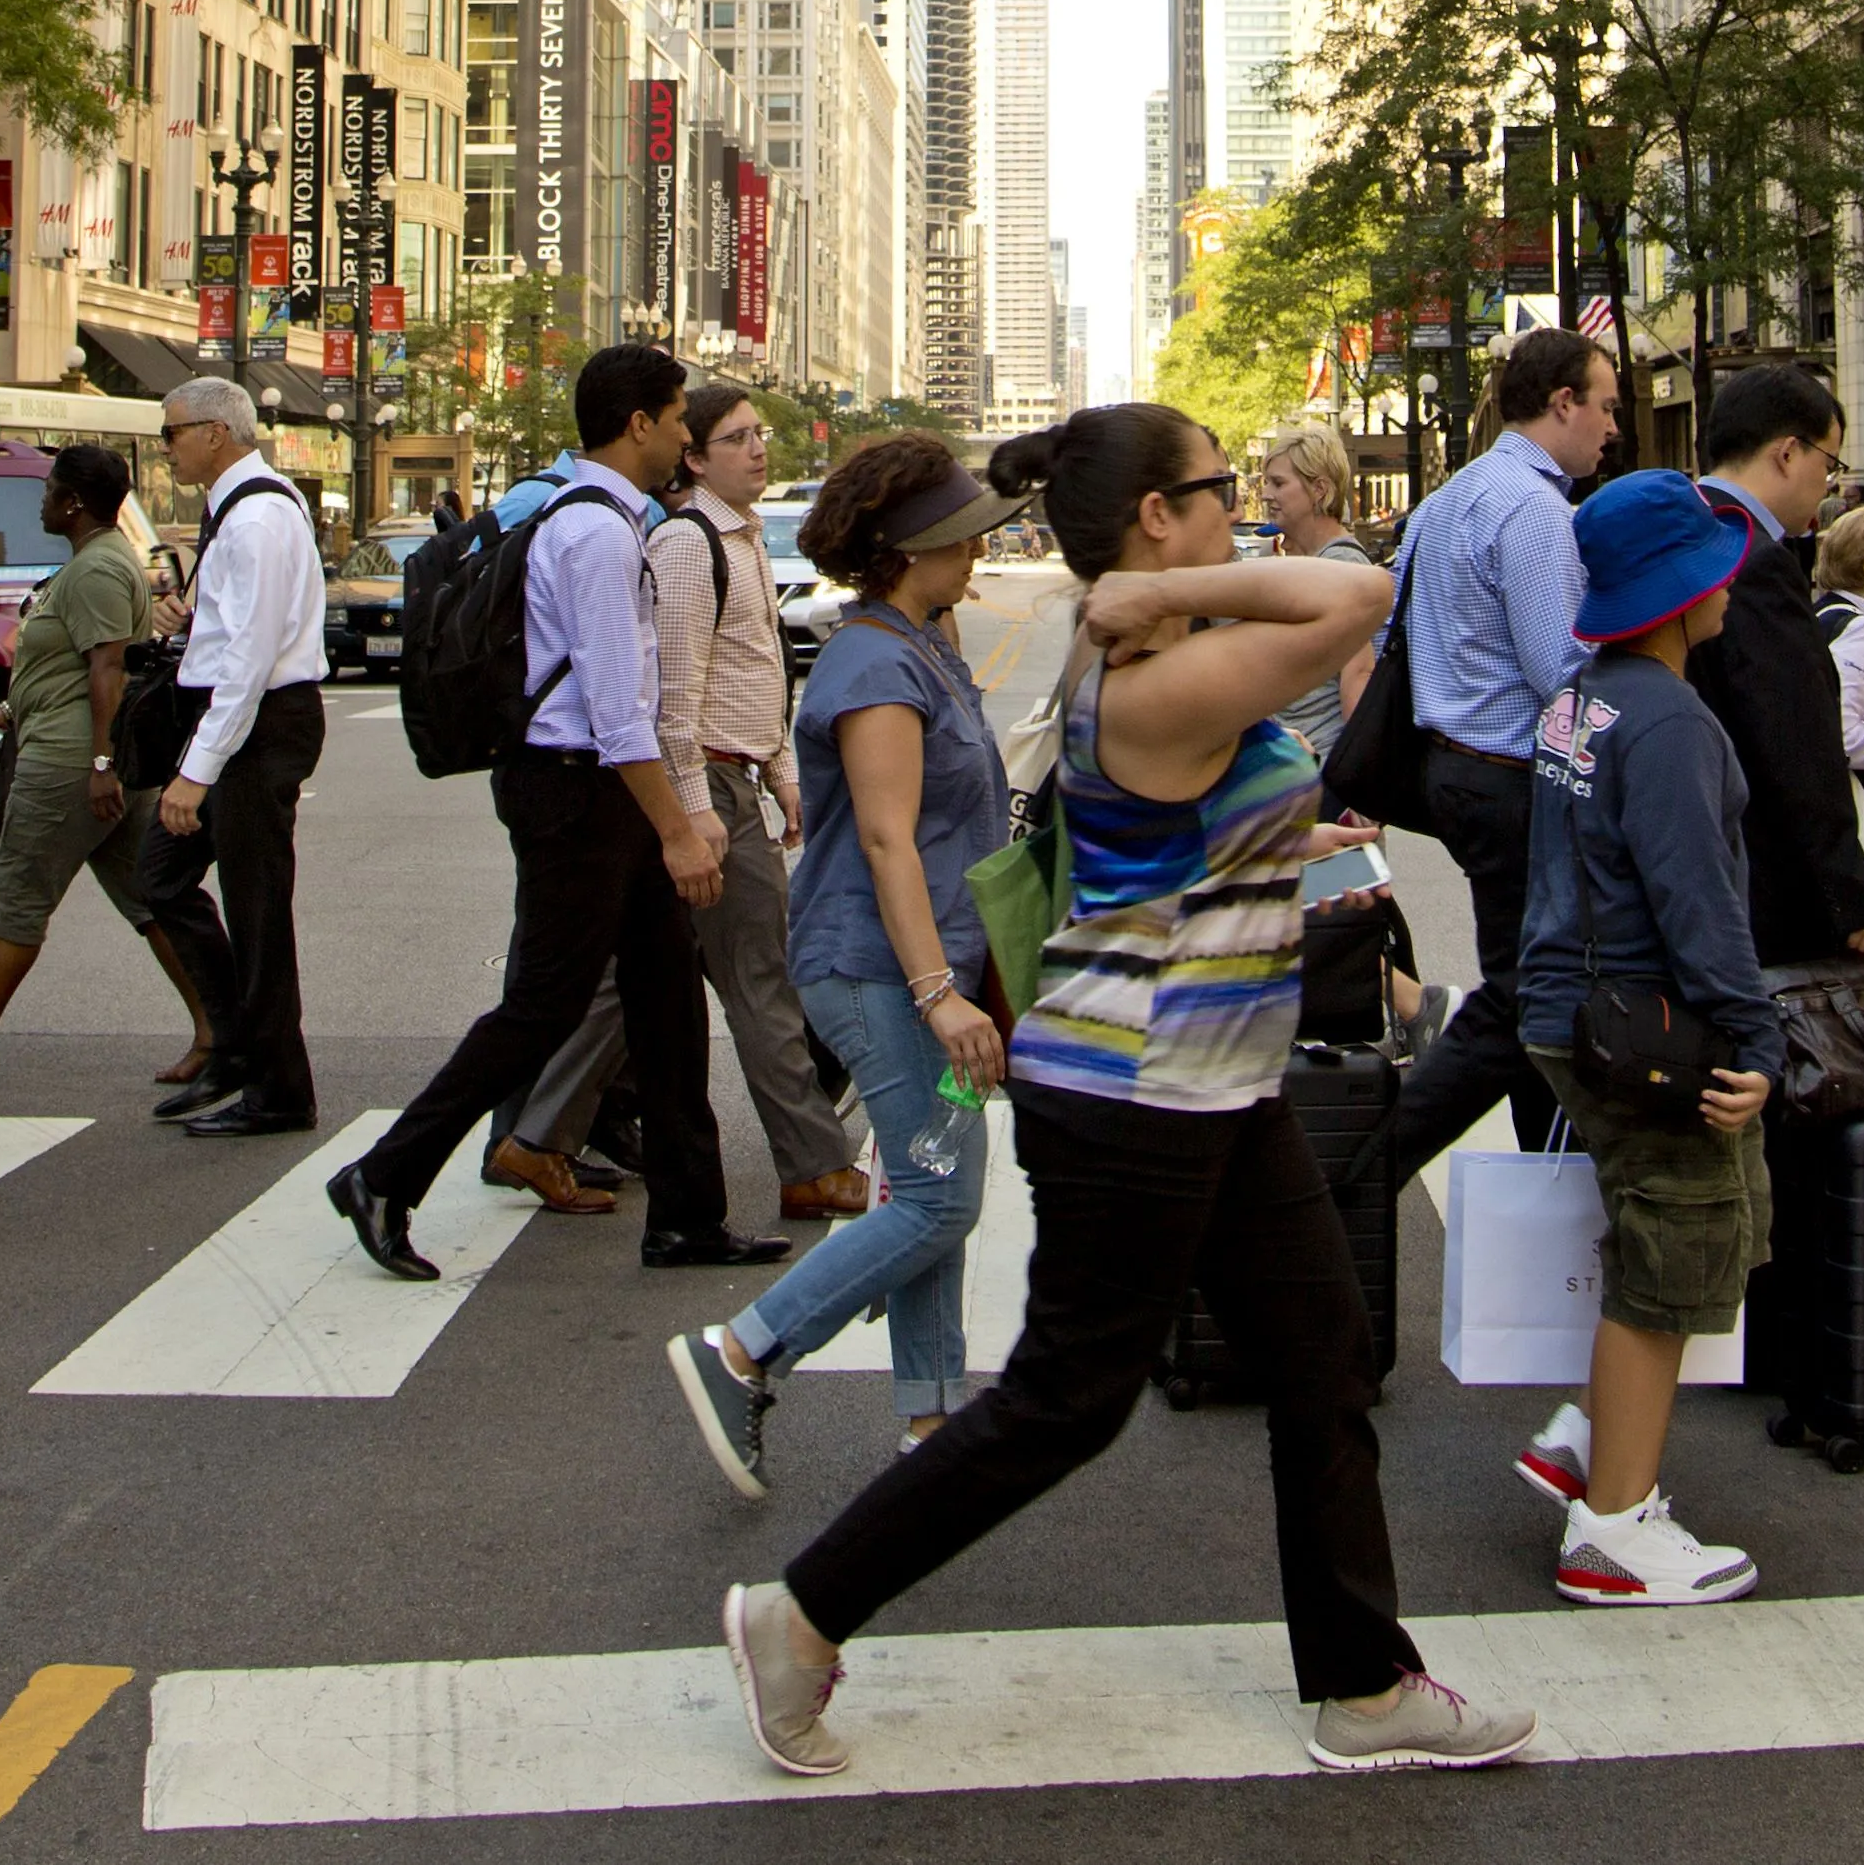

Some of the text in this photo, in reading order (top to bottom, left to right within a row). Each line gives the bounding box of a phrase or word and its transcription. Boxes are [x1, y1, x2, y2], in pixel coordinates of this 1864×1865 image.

[166, 118, 195, 138] H&M
[539, 75, 563, 164] THIRTY
[292, 67, 320, 298] NORDSTROM rack
[39, 203, 71, 225] H&M
[83, 217, 114, 239] H&M
[537, 171, 563, 261] BLOCK
[704, 180, 724, 273] francesca's
[754, 195, 765, 229] STATE
[163, 240, 191, 261] H&M
[721, 198, 732, 290] BANANA REPUBLIC
[740, 195, 751, 316] SHOPPING DINING
[203, 255, 235, 278] 50
[754, 271, 765, 284] AT
[754, 288, 765, 325] SHOPS
